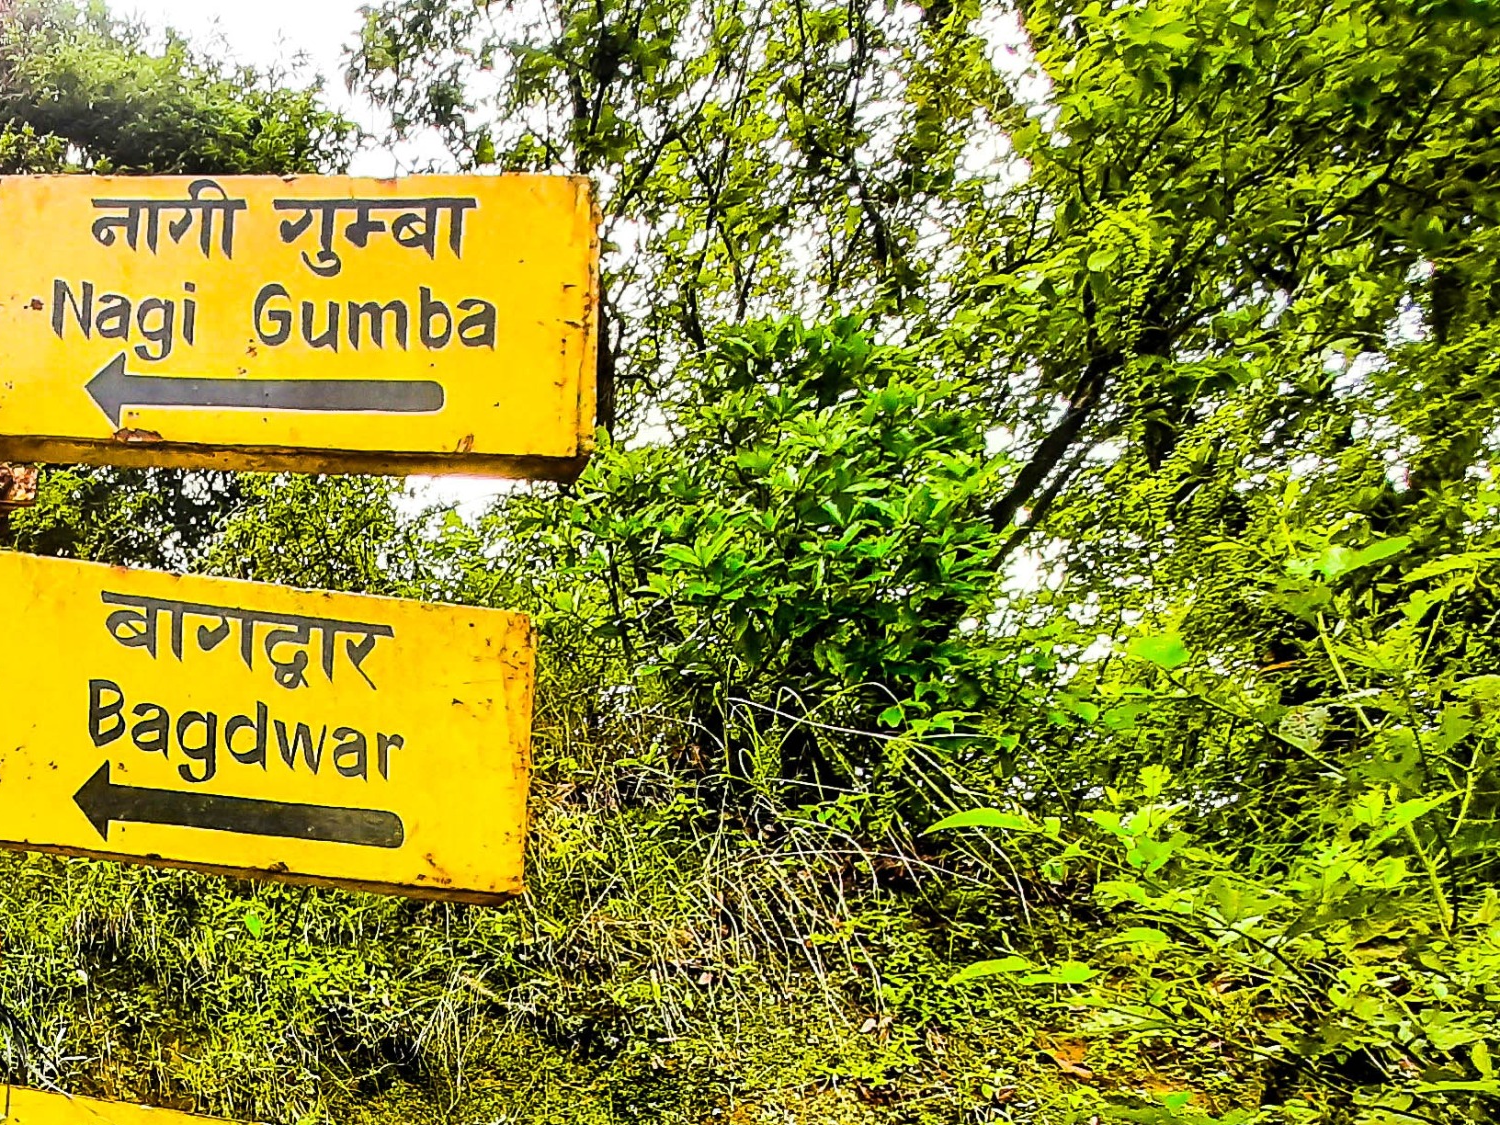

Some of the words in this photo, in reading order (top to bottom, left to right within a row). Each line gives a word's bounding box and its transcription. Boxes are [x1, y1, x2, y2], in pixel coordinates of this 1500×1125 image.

[91, 179, 247, 260] नागी
[273, 197, 477, 278] गुम्बा
[51, 279, 196, 361] Nagi
[254, 283, 497, 353] Gumba
[100, 590, 395, 691] बागद्वार
[87, 678, 405, 784] Bagdwar
